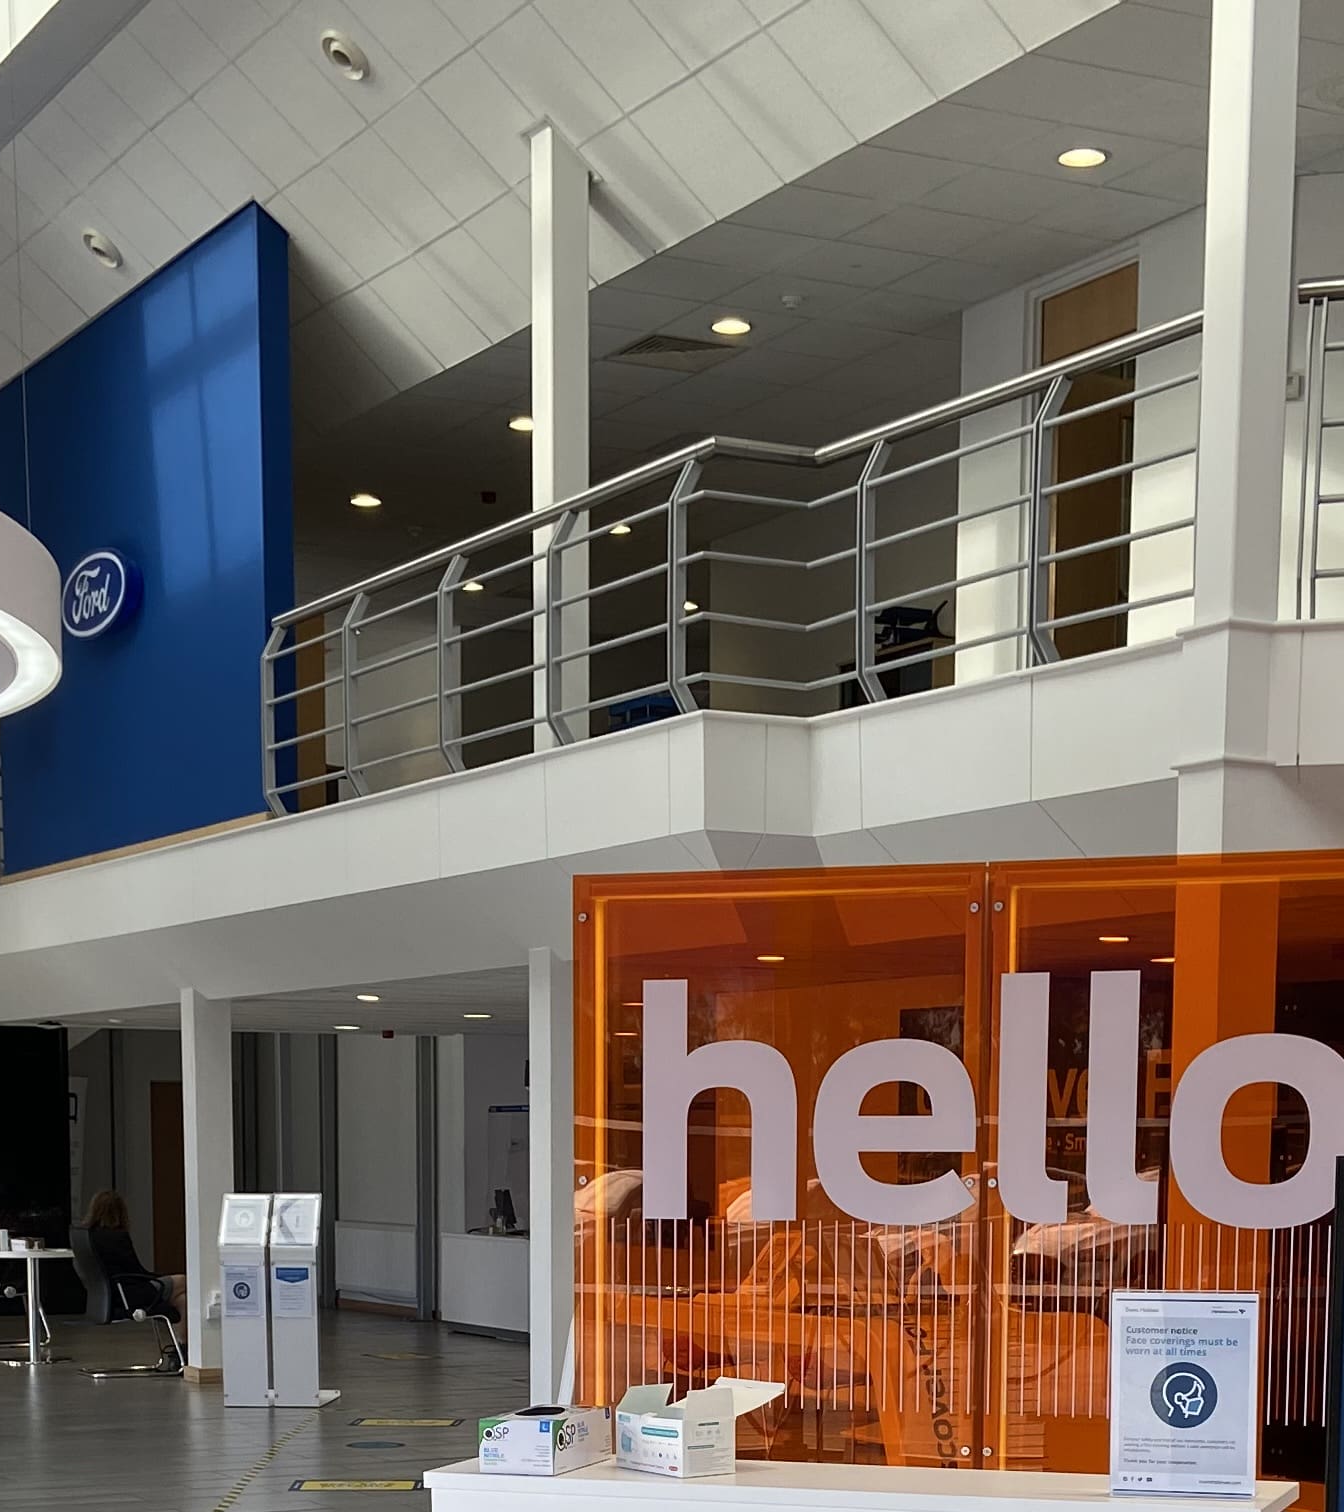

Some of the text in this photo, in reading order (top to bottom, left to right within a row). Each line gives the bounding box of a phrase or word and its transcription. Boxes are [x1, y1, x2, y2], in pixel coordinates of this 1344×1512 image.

[72, 566, 110, 624] Ford
[1126, 1326, 1198, 1335] Customer notice
[1126, 1337, 1147, 1345] Face
[1150, 1337, 1195, 1347] coverings
[1226, 1338, 1238, 1346] be
[1165, 1348, 1177, 1356] all
[1179, 1348, 1207, 1357] times
